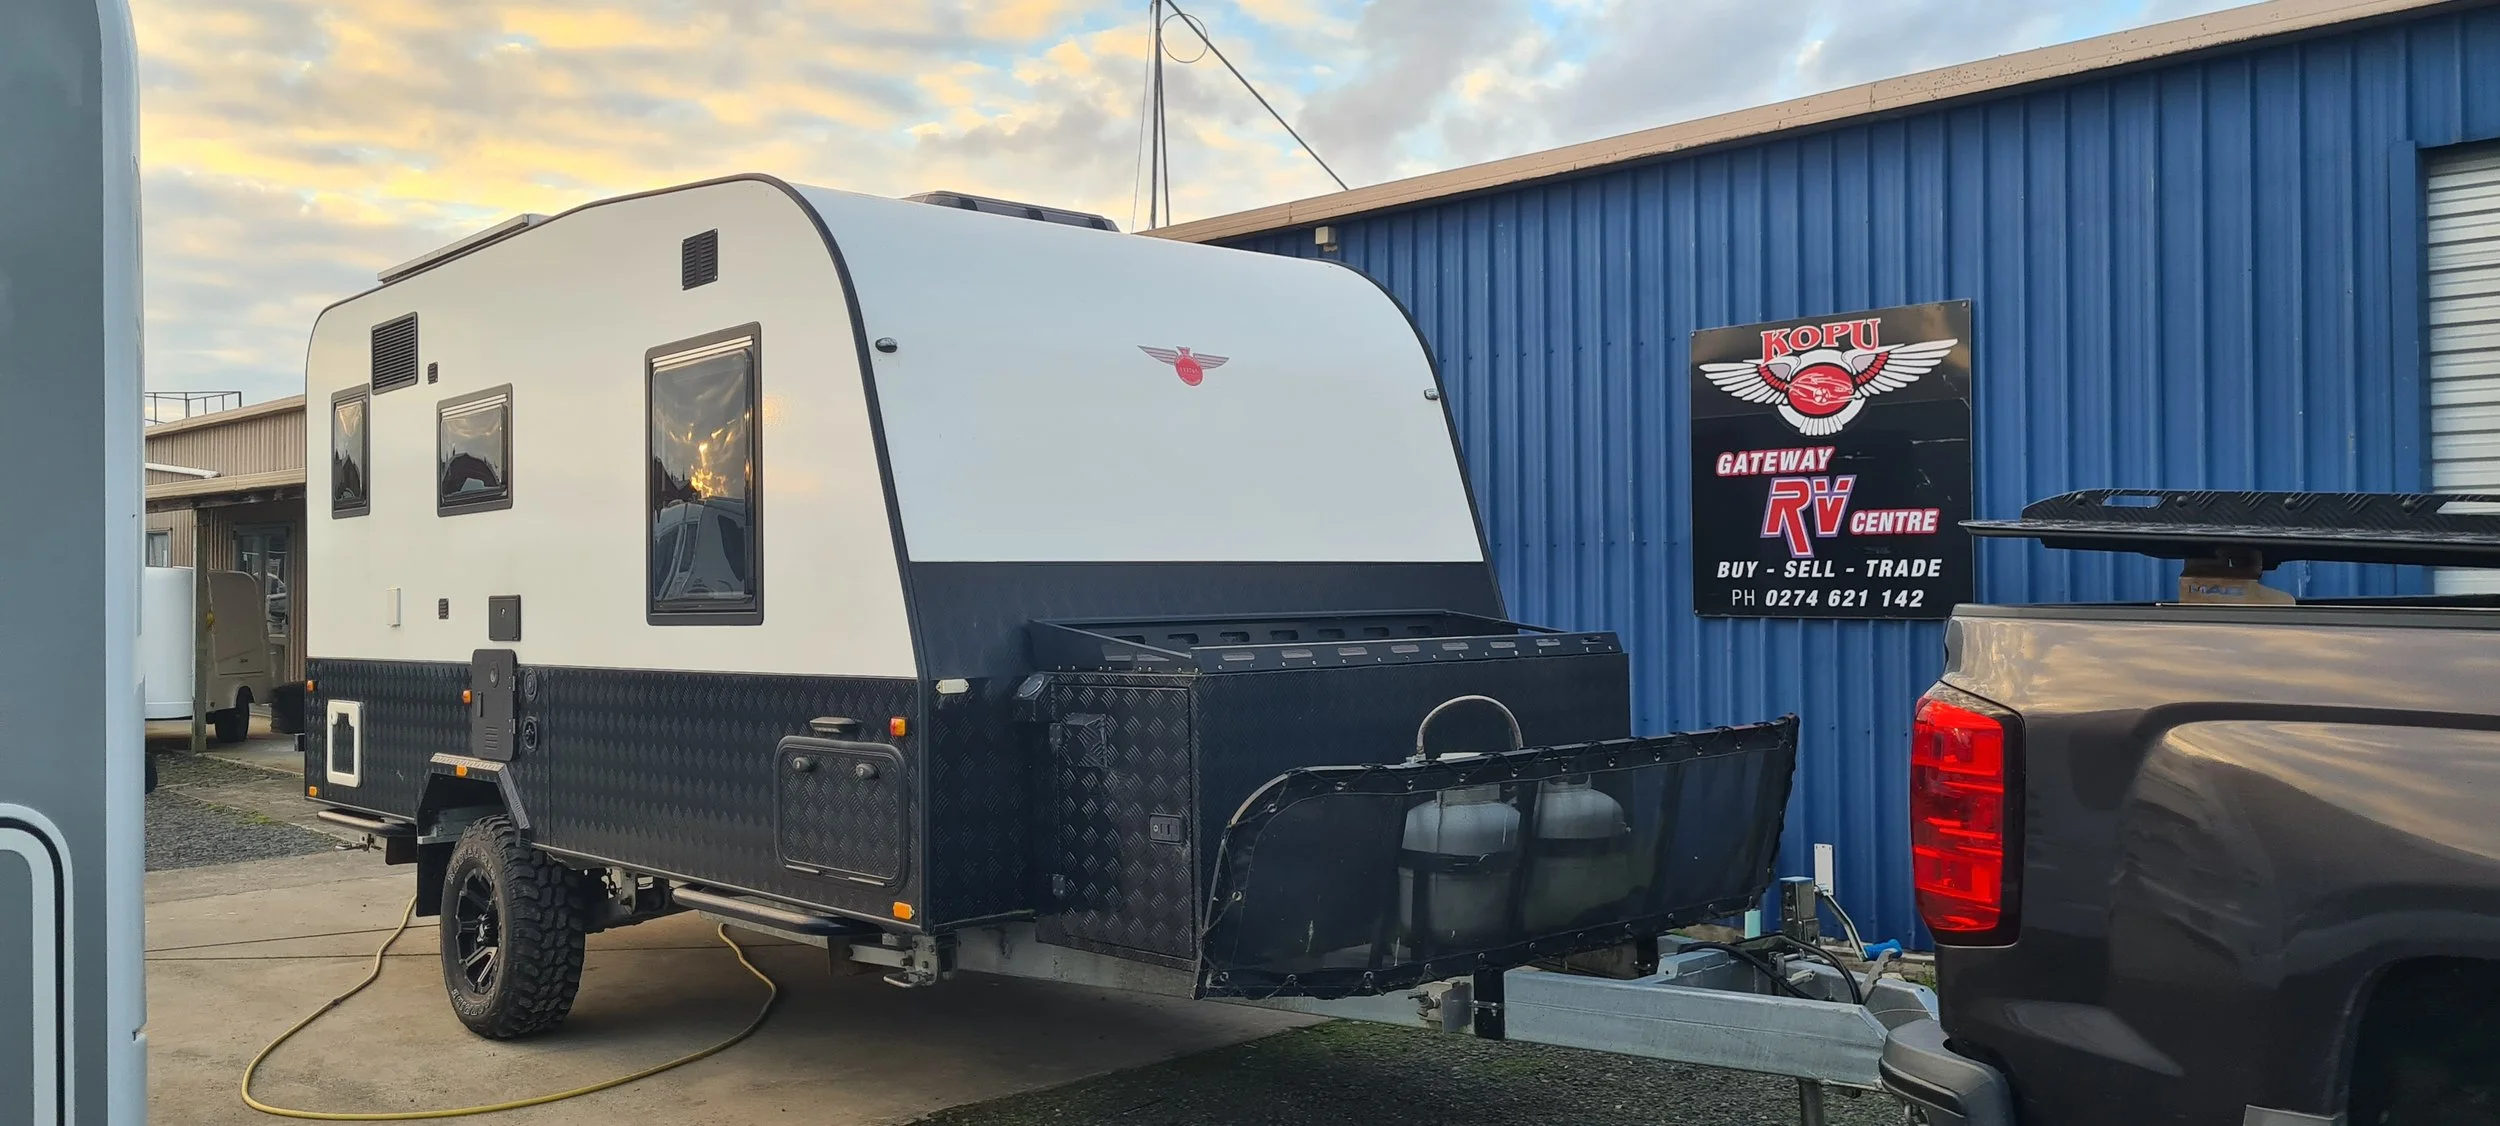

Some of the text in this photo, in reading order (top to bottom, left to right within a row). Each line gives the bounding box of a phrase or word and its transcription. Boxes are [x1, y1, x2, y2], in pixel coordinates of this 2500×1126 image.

[1761, 317, 1881, 366] KOPU
[1717, 446, 1835, 476] GATEWAY
[1760, 475, 1940, 558] RV CENTRE
[1717, 561, 1758, 578] BUY
[1784, 560, 1835, 578] SELL
[1866, 558, 1942, 577] TRADE
[1732, 589, 1924, 608] PH 0274 621 142
